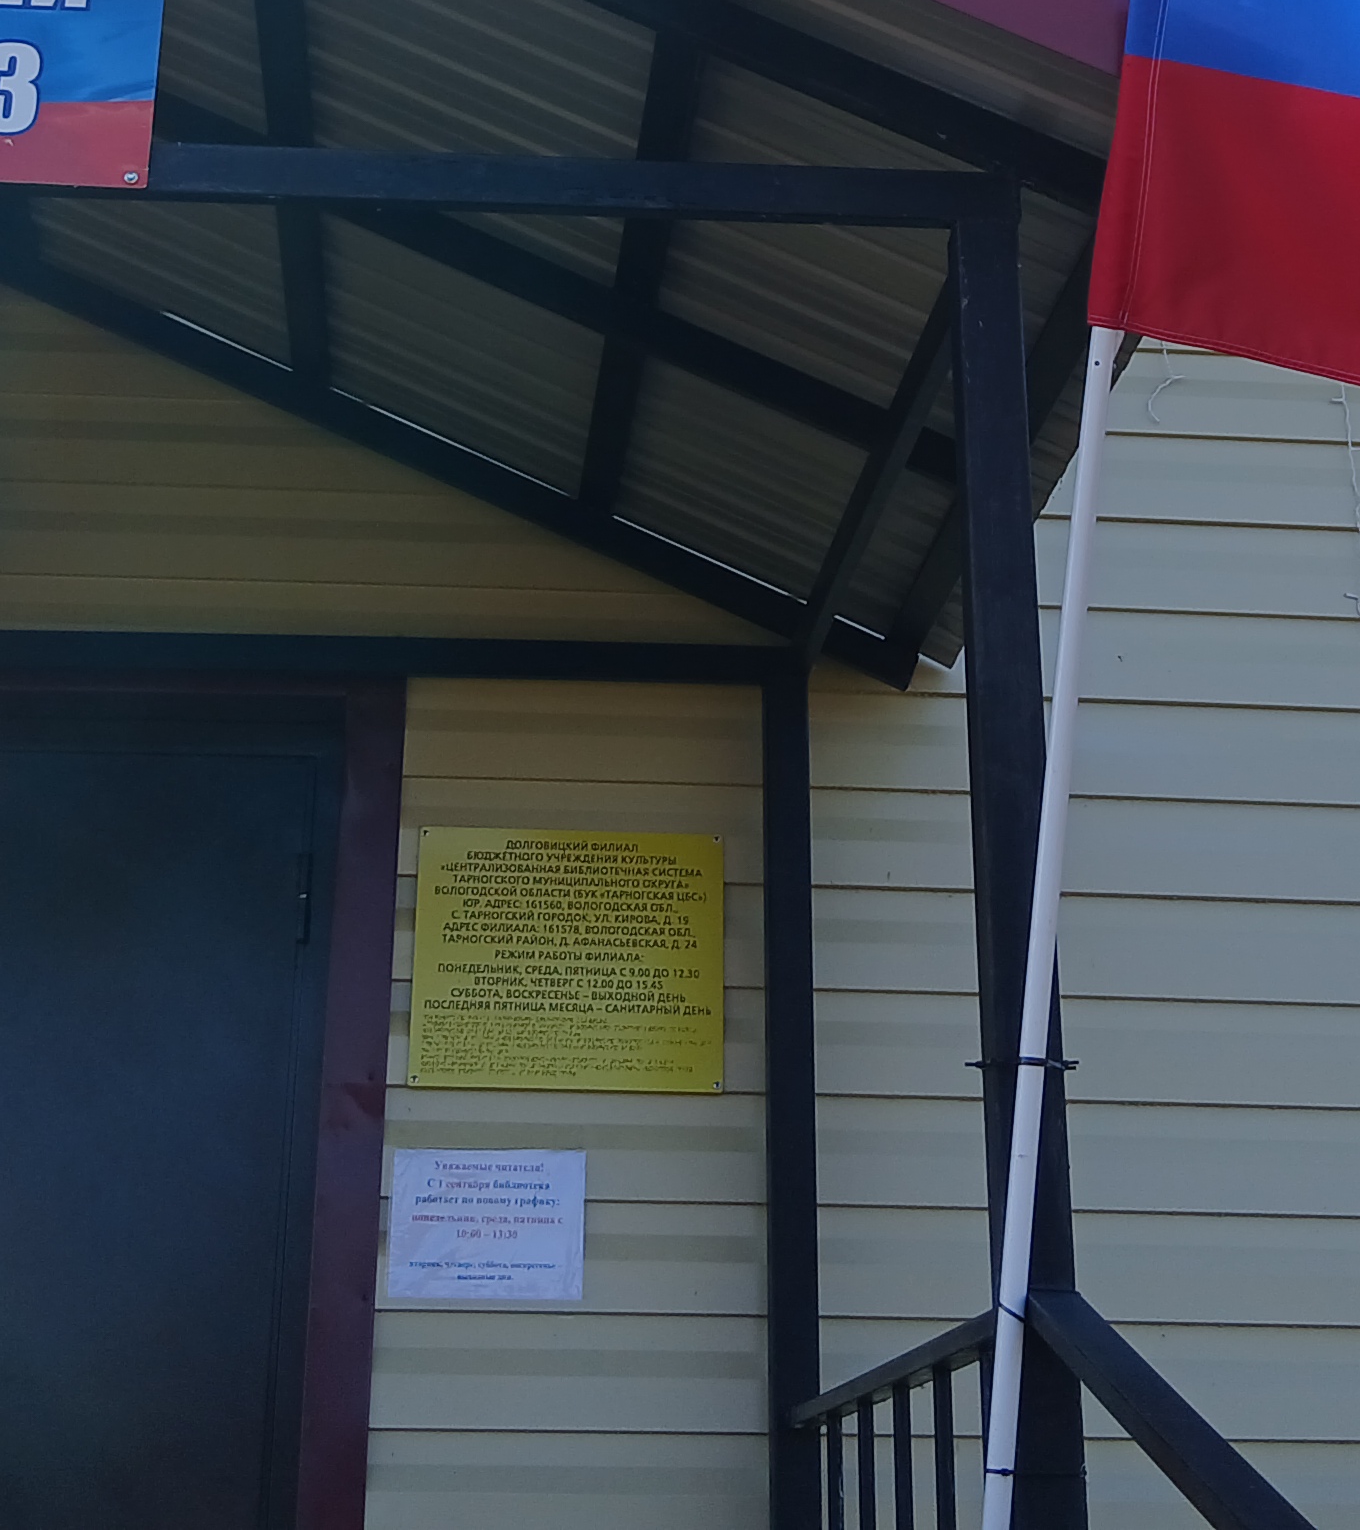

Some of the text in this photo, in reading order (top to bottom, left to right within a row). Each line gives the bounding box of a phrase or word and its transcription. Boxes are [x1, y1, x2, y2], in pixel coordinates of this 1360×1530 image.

[505, 839, 639, 854] ДОЛГОВИЦКИЙ ФИЛИАЛ
[467, 850, 677, 866] БЮДЖЕТНОГО УЧРЕЖДЕНИЯ КУЛЬТУРЫ
[440, 862, 703, 878] «ЦЕНТРАЛИЗОВАННАЯ БИБЛИОТЕЧНАЯ СИСТЕМА
[452, 873, 531, 885] ТАРНОГСКОГО
[532, 875, 640, 888] МУНИЦИПАЛЬНОГО
[434, 885, 518, 898] ВОЛОГОДСКОЙ
[520, 887, 571, 898] ОБЛАСТИ
[573, 889, 598, 900] (БУК
[599, 889, 674, 902] «ТАРНОГСКАЯ
[525, 900, 566, 912] 161560,
[567, 901, 648, 913] ВОЛОГОДСКАЯ
[464, 910, 535, 922] ТАРНОГСКИЙ
[677, 915, 690, 926] 19
[443, 921, 480, 933] АДРЕС
[480, 922, 540, 934] ФИЛИАЛА:
[543, 923, 583, 936] 161578,
[585, 925, 666, 938] ВОЛОГОДСКАЯ
[442, 932, 514, 945] ТАРНОГСКИЙ
[516, 934, 558, 947] РАЙОН,
[684, 939, 698, 950] 24
[494, 949, 535, 961] РЕЖИМ
[537, 950, 583, 962] РАБОТЫ
[437, 962, 523, 976] ПОНЕДЕЛЬНИК,
[564, 965, 617, 978] ПЯТНИЦА
[619, 967, 627, 977] С
[628, 967, 651, 979] 9.00
[652, 968, 670, 980] ДО
[673, 968, 701, 980] 12.30
[530, 977, 574, 989] ЧЕТВЕРГ
[576, 978, 584, 989] С
[586, 978, 614, 990] 12.00
[615, 979, 633, 991] ДО
[636, 980, 664, 991] 15.45
[506, 988, 581, 1001] ВОСКРЕСЕНЬЕ
[591, 990, 655, 1004] ВЫХОДНОЙ
[657, 992, 687, 1005] ДЕНЬ
[424, 999, 491, 1013] ПОСЛЕДНЯЯ
[493, 1000, 547, 1013] ПЯТНИЦА
[548, 1002, 595, 1015] МЕСЯЦА
[605, 1002, 682, 1016] САНИТАРНЫЙ
[683, 1005, 713, 1017] ДЕНЬ
[427, 1178, 436, 1189] С
